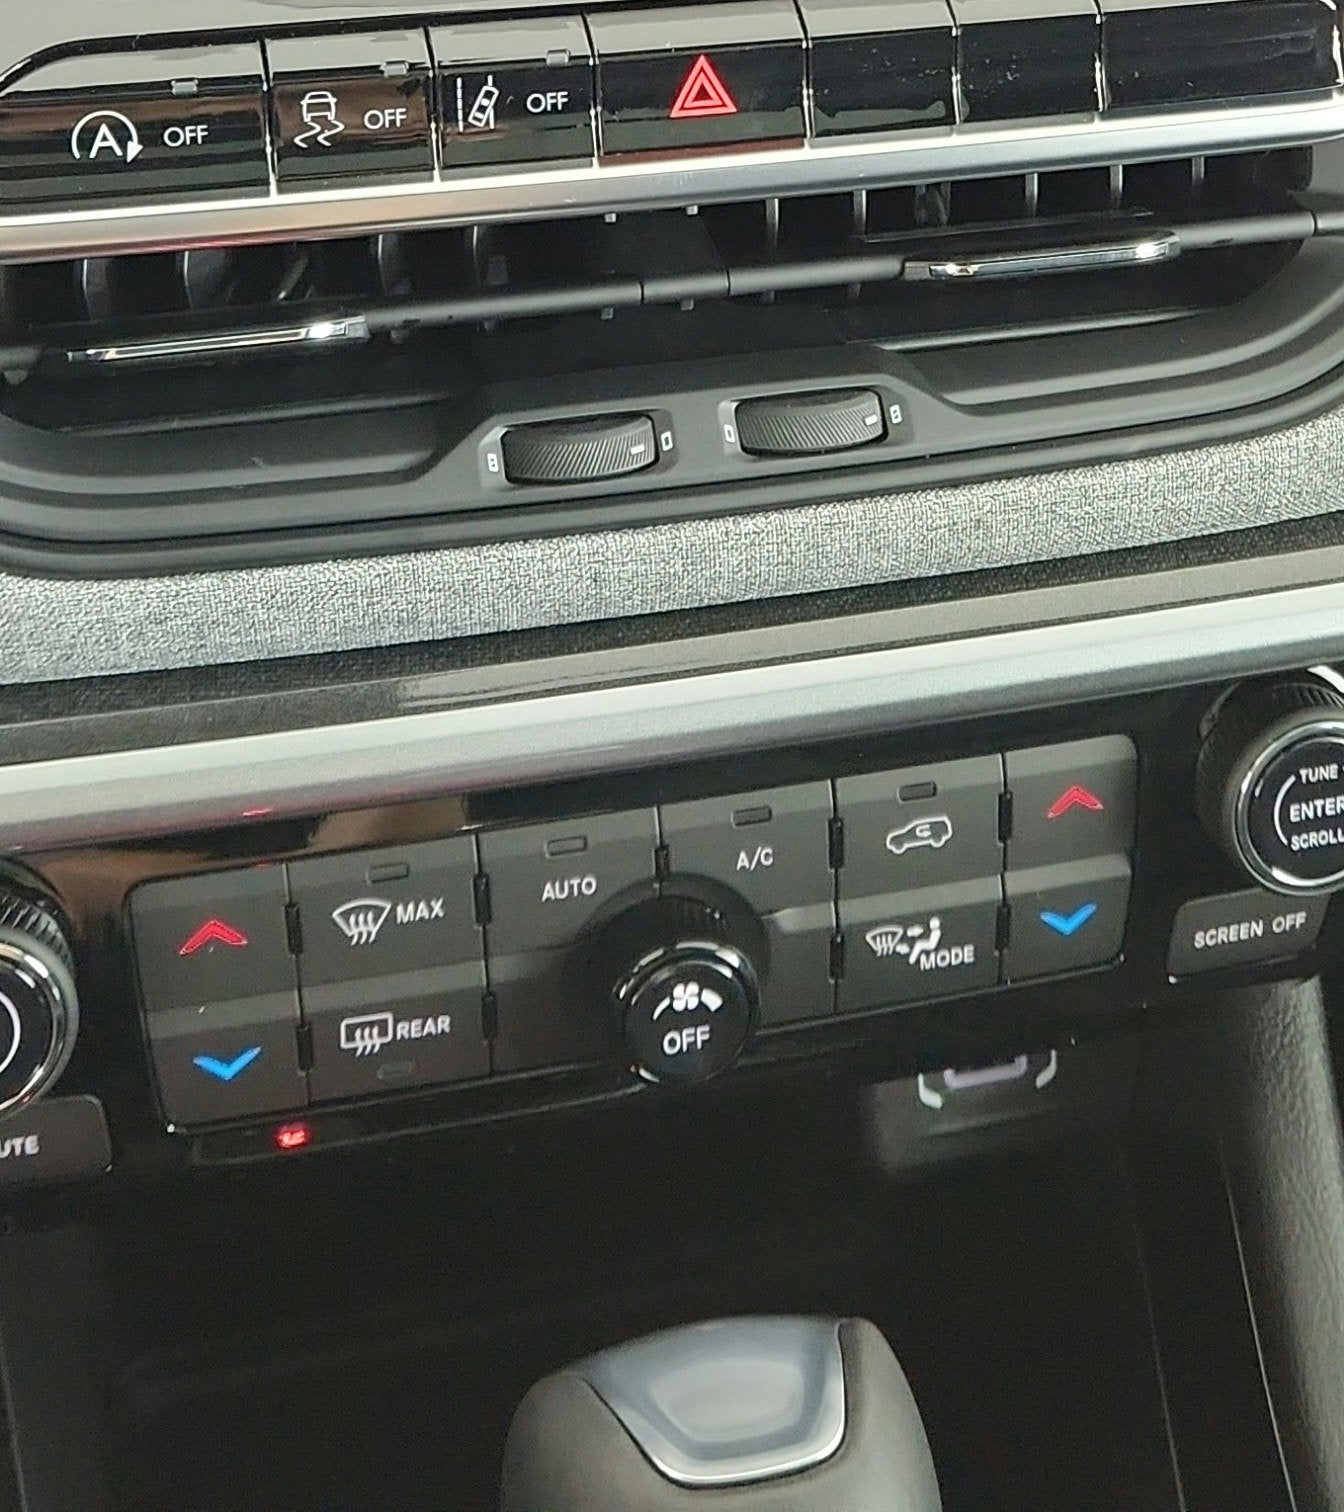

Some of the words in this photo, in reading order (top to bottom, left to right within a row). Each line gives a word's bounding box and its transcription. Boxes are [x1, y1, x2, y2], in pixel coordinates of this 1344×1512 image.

[526, 91, 569, 114] OFF
[363, 107, 408, 130] OFF
[163, 124, 209, 147] OFF
[1299, 763, 1340, 784] TUNE
[736, 846, 774, 871] A/C
[541, 876, 598, 903] AUTO
[395, 898, 445, 924] MAX
[1193, 918, 1264, 949] SCREEN
[1272, 911, 1308, 934] OFF
[919, 944, 975, 970] MODE
[396, 1014, 451, 1041] REAR
[663, 1024, 711, 1056] OFF
